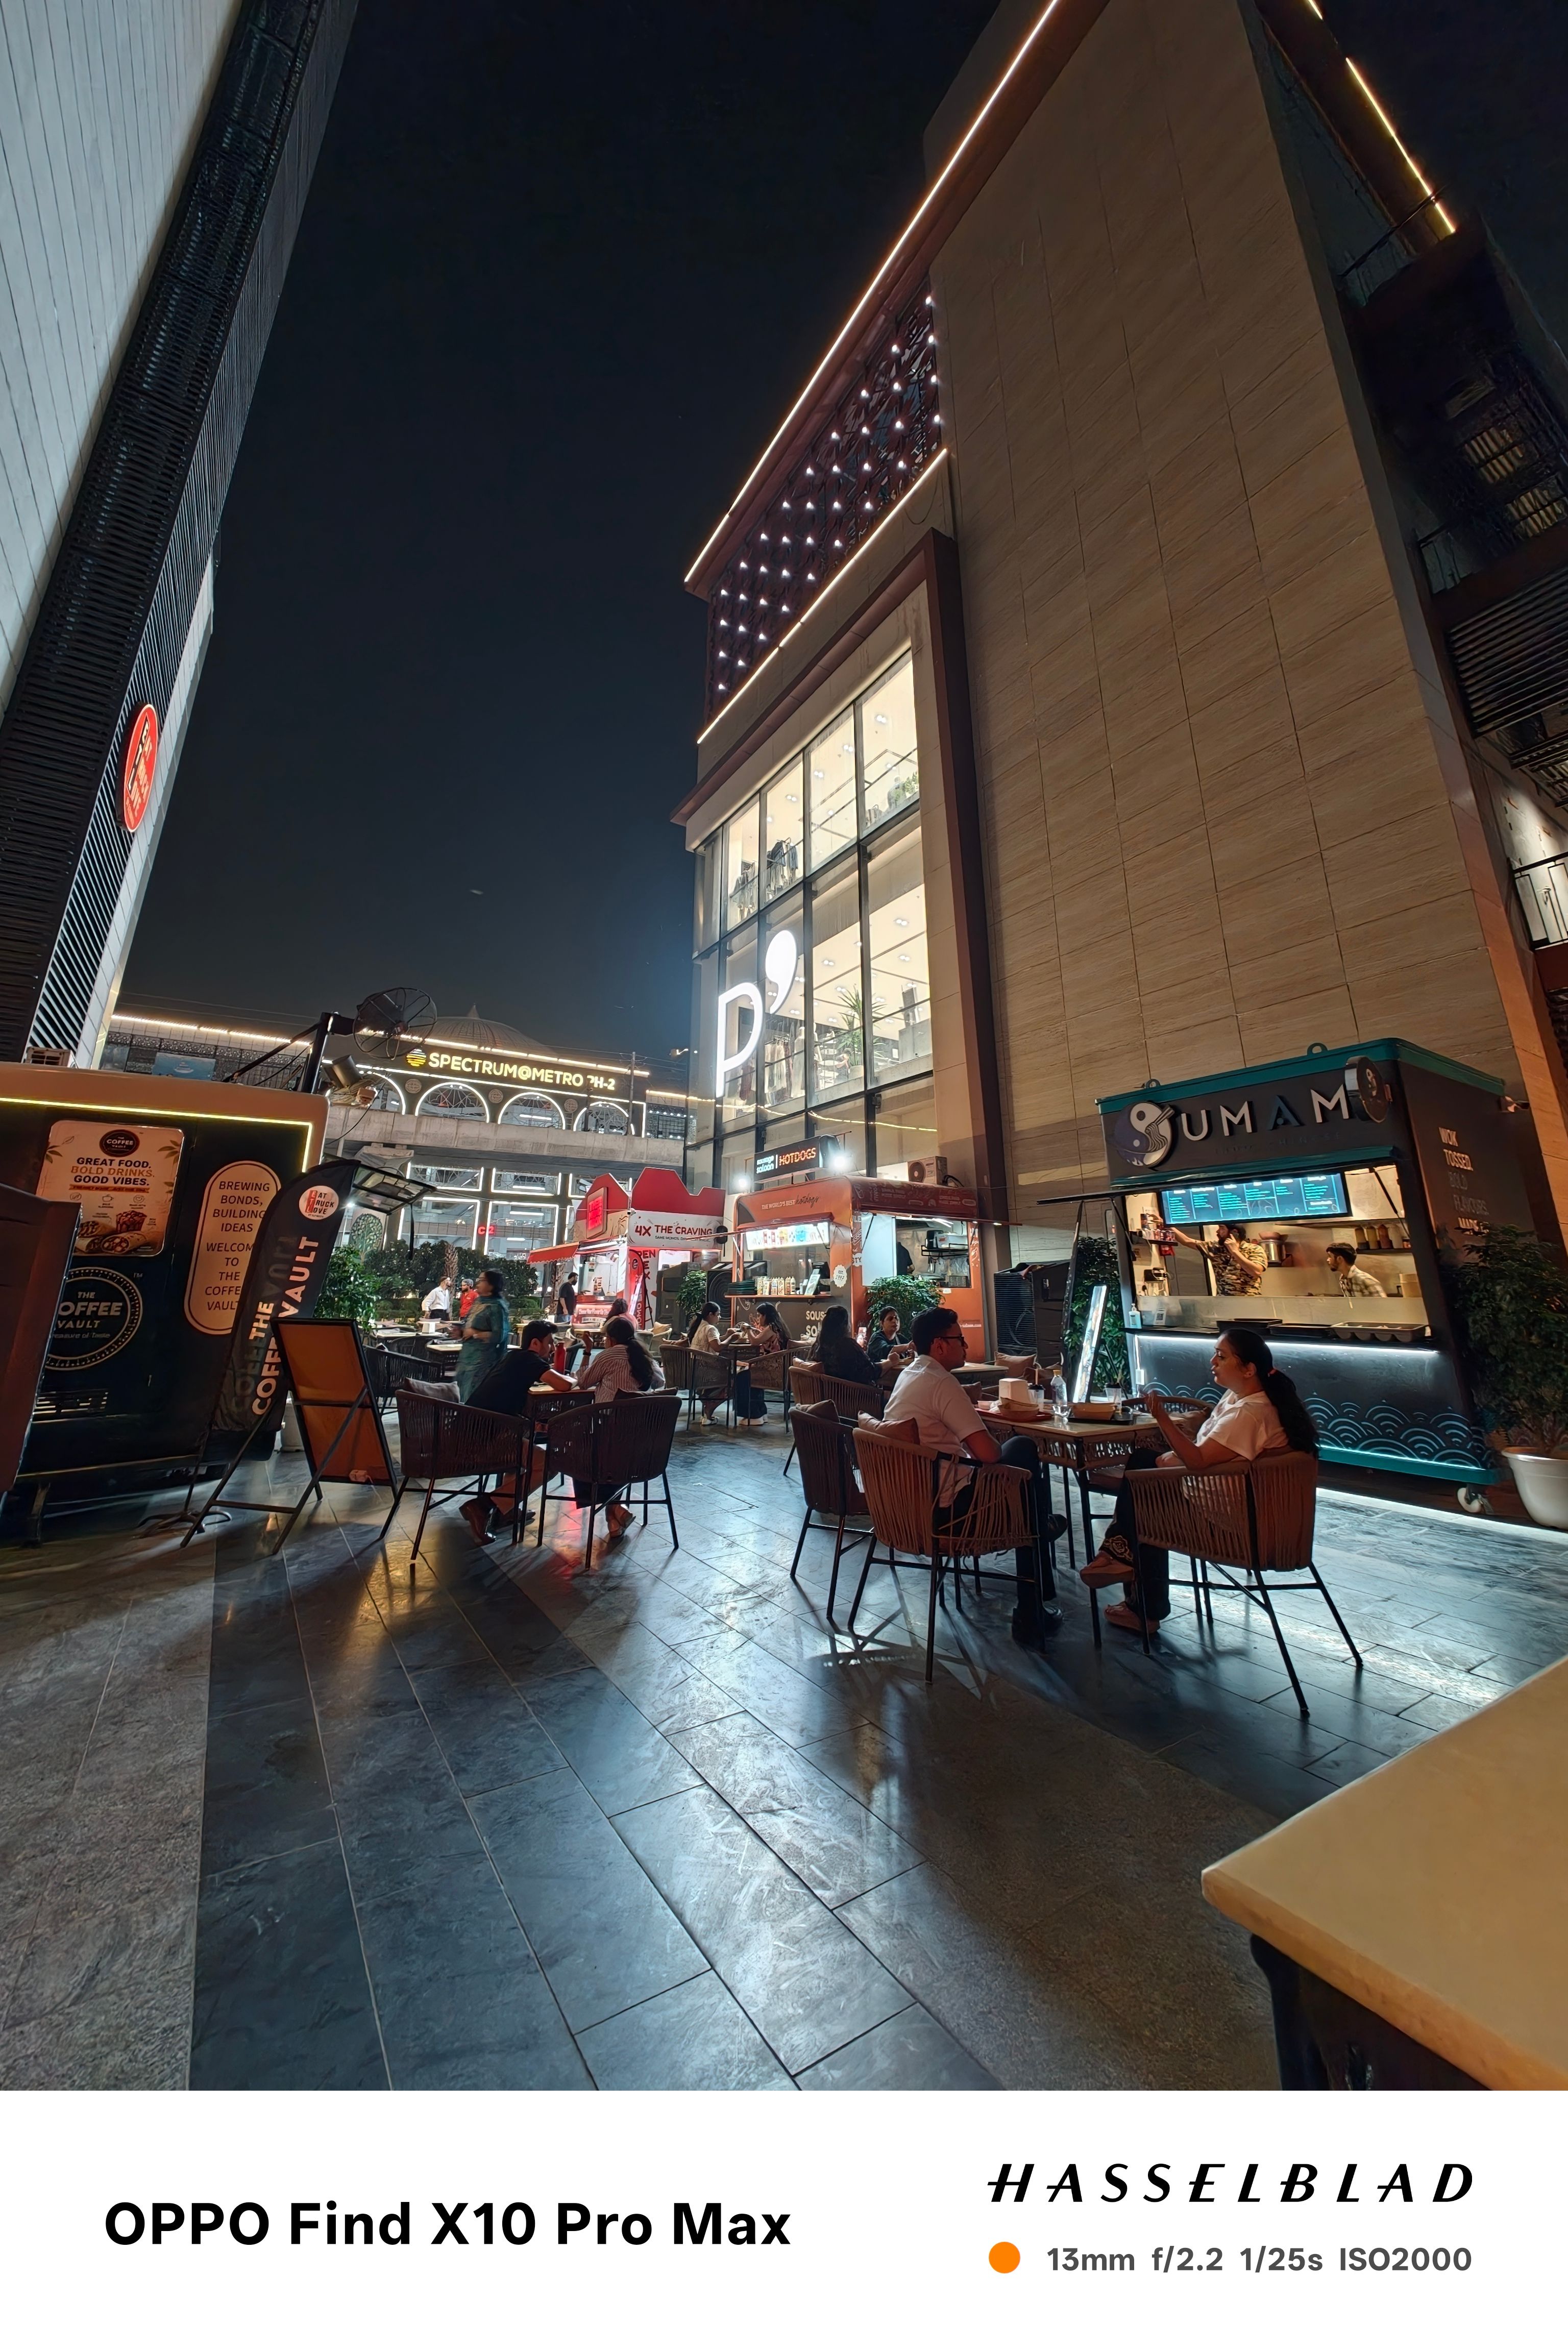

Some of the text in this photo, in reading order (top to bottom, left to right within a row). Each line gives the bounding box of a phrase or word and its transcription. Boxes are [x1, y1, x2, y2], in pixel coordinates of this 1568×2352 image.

[428, 1052, 584, 1086] SPECTRUM@METRO
[1181, 1084, 1349, 1141] UMAM
[779, 1147, 816, 1166] HOTDOGS
[77, 1157, 151, 1168] GREAT FOOD.
[71, 1166, 155, 1177] BOLD DRINKS.
[74, 1175, 150, 1186] GOOD VIBES.
[219, 1181, 270, 1191] BREWING
[220, 1195, 263, 1206] BONDS,
[213, 1209, 265, 1218] BUILDING
[221, 1223, 253, 1232] IDEAS
[634, 1225, 713, 1237] 4X THE CRAVING
[206, 1242, 255, 1252] WELCOM
[225, 1258, 239, 1266] TO
[218, 1272, 240, 1281] THE
[205, 1286, 241, 1295] COFFE
[58, 1302, 123, 1316] OFFEE
[57, 1320, 101, 1329] VAULT
[249, 1302, 274, 1340] THE
[252, 1335, 281, 1416] COFF
[278, 1237, 318, 1318] VAULT
